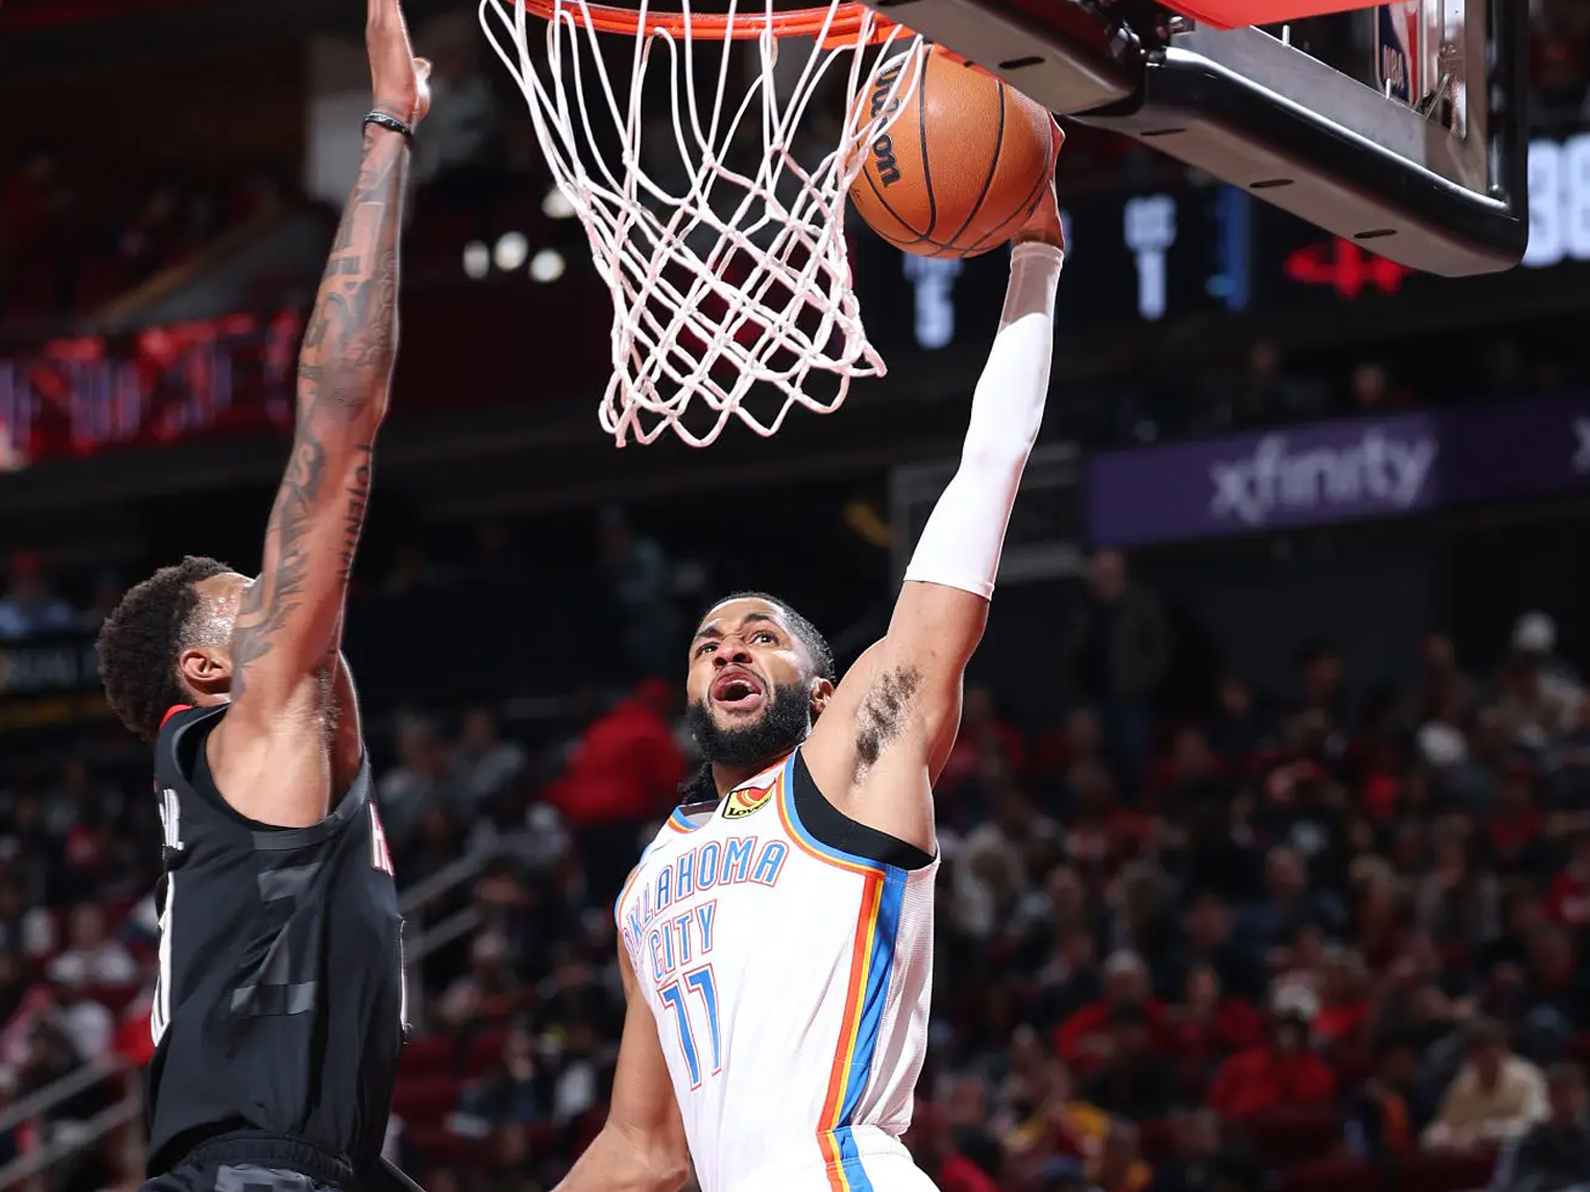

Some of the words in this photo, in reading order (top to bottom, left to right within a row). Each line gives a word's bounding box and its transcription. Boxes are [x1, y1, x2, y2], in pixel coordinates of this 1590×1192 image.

[1209, 428, 1437, 525] xfinity
[623, 836, 789, 962] OKLAHOMA
[648, 899, 717, 983] CITY
[658, 963, 722, 1091] 11
